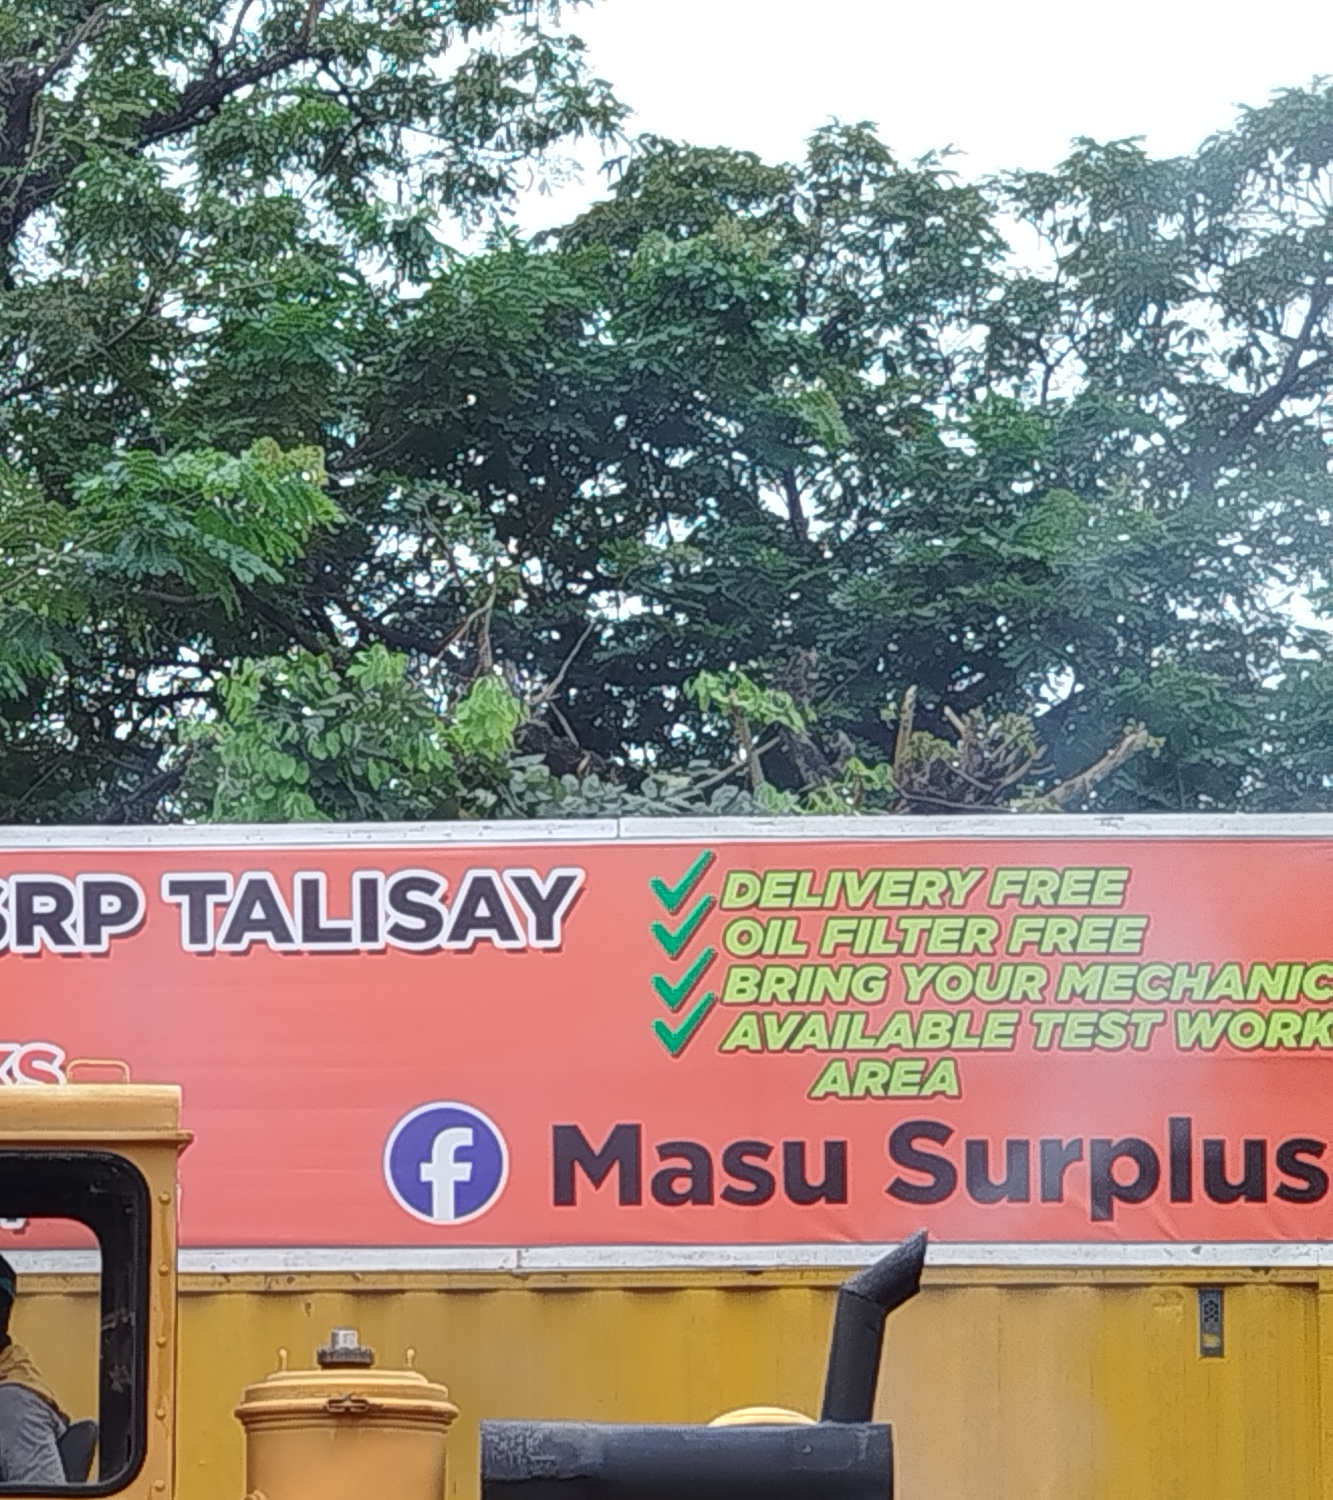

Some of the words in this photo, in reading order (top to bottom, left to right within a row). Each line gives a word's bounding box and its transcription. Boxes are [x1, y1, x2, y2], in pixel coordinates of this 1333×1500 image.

[161, 867, 584, 953] TALISAY
[719, 869, 983, 909] DELIVERY
[988, 867, 1132, 907] FREE
[720, 917, 809, 956] OIL
[819, 917, 1000, 956] FILTER
[1005, 916, 1150, 955] FREE
[720, 964, 888, 1005] BRING
[902, 964, 1049, 1004] YOUR
[1054, 961, 1333, 1004] MECHANIC
[719, 1010, 1019, 1052] AVAILABLE
[1033, 1010, 1164, 1051] TEST
[1174, 1008, 1333, 1051] WORK
[808, 1058, 961, 1098] AREA
[552, 1123, 847, 1206] Masu
[885, 1117, 1330, 1221] Surplus
